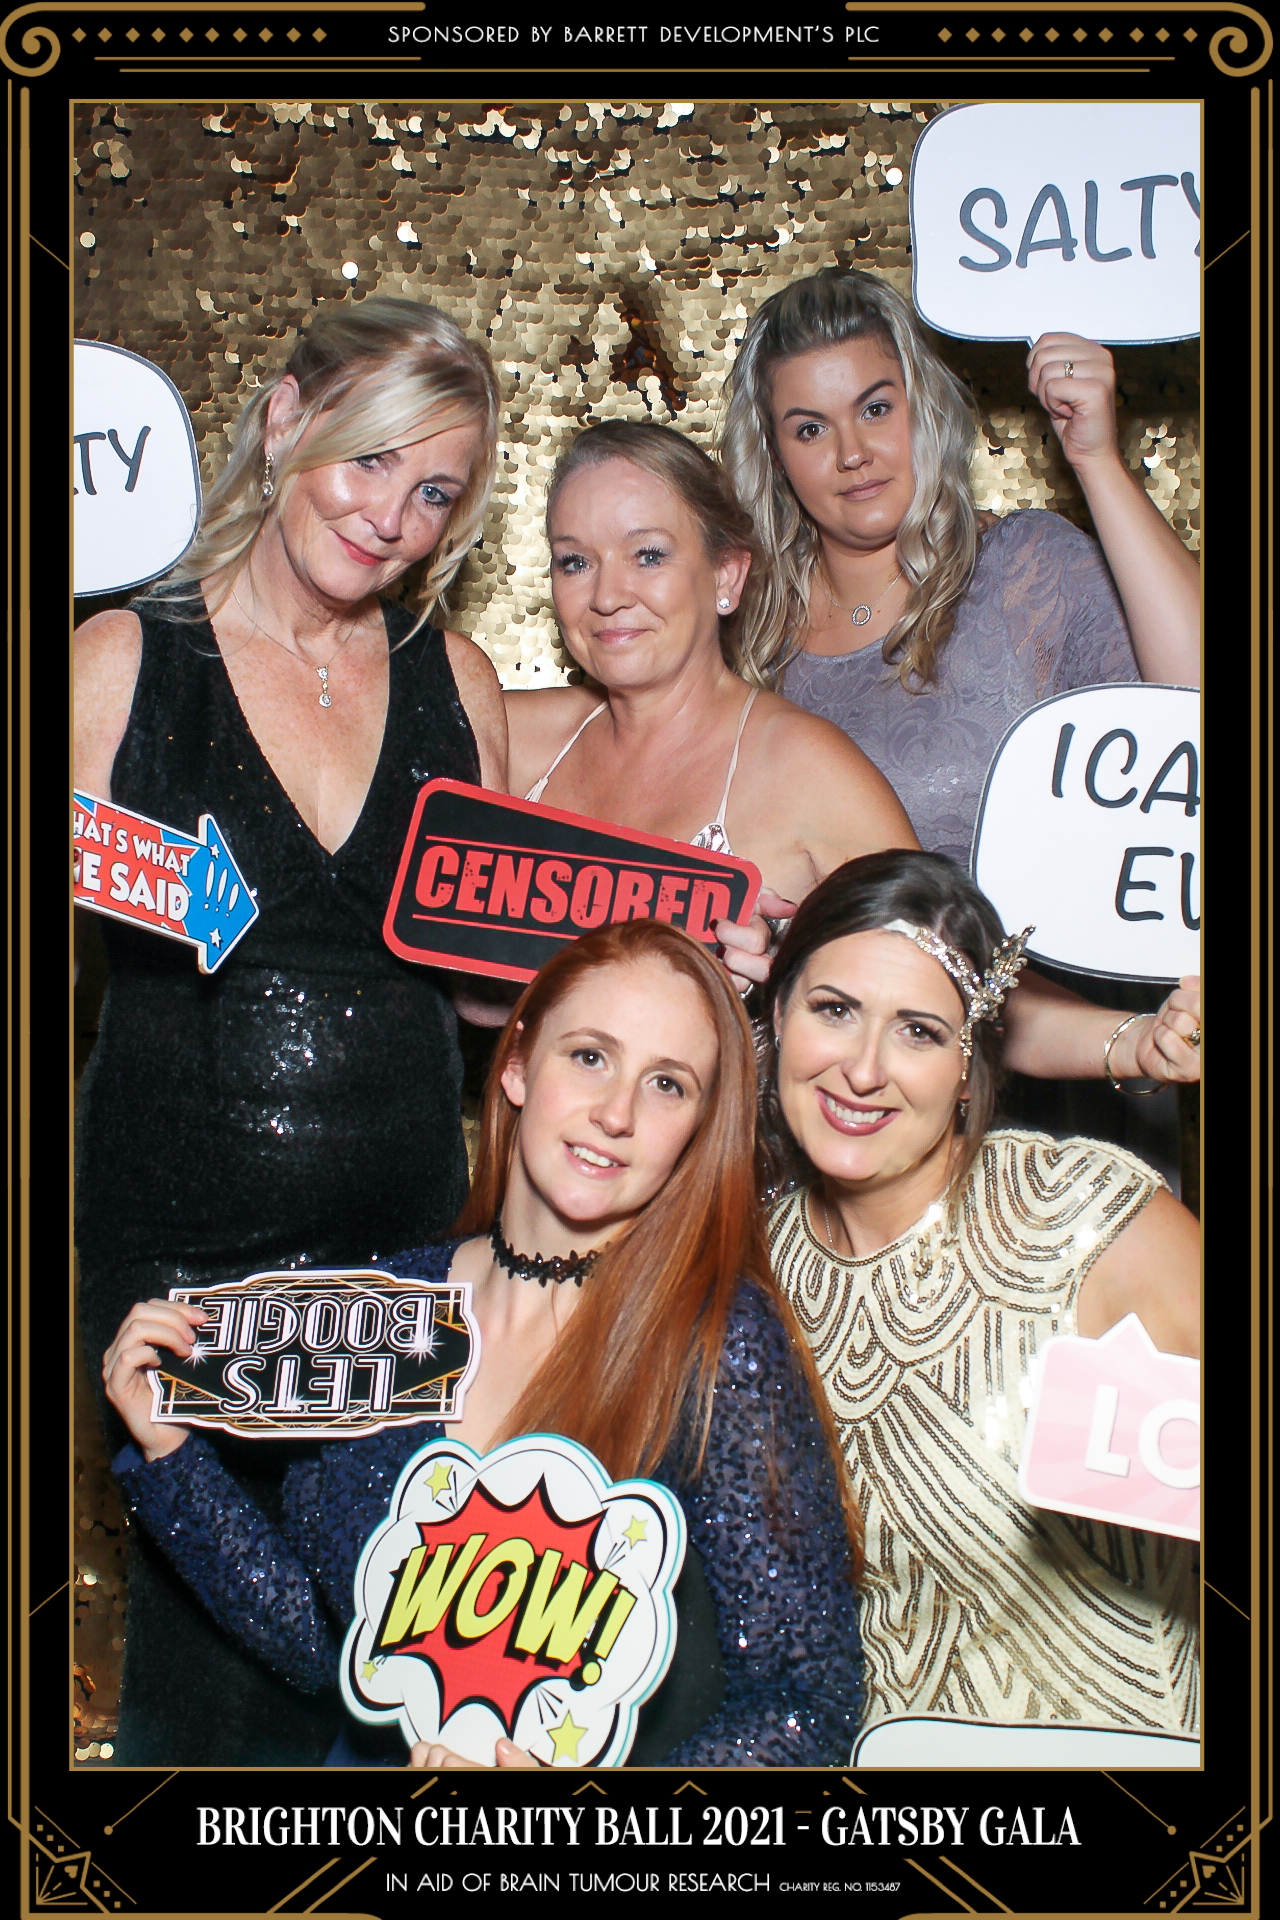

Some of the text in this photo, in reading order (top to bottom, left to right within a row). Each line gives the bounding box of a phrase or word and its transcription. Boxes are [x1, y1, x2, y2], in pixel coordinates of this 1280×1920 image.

[74, 425, 152, 496] TY
[74, 846, 190, 922] E SAID
[132, 834, 191, 878] WHAT
[414, 845, 732, 944] CENSORED
[195, 1293, 436, 1354] BOOGIE
[219, 1354, 397, 1415] LETS
[370, 1533, 638, 1690] WOW!
